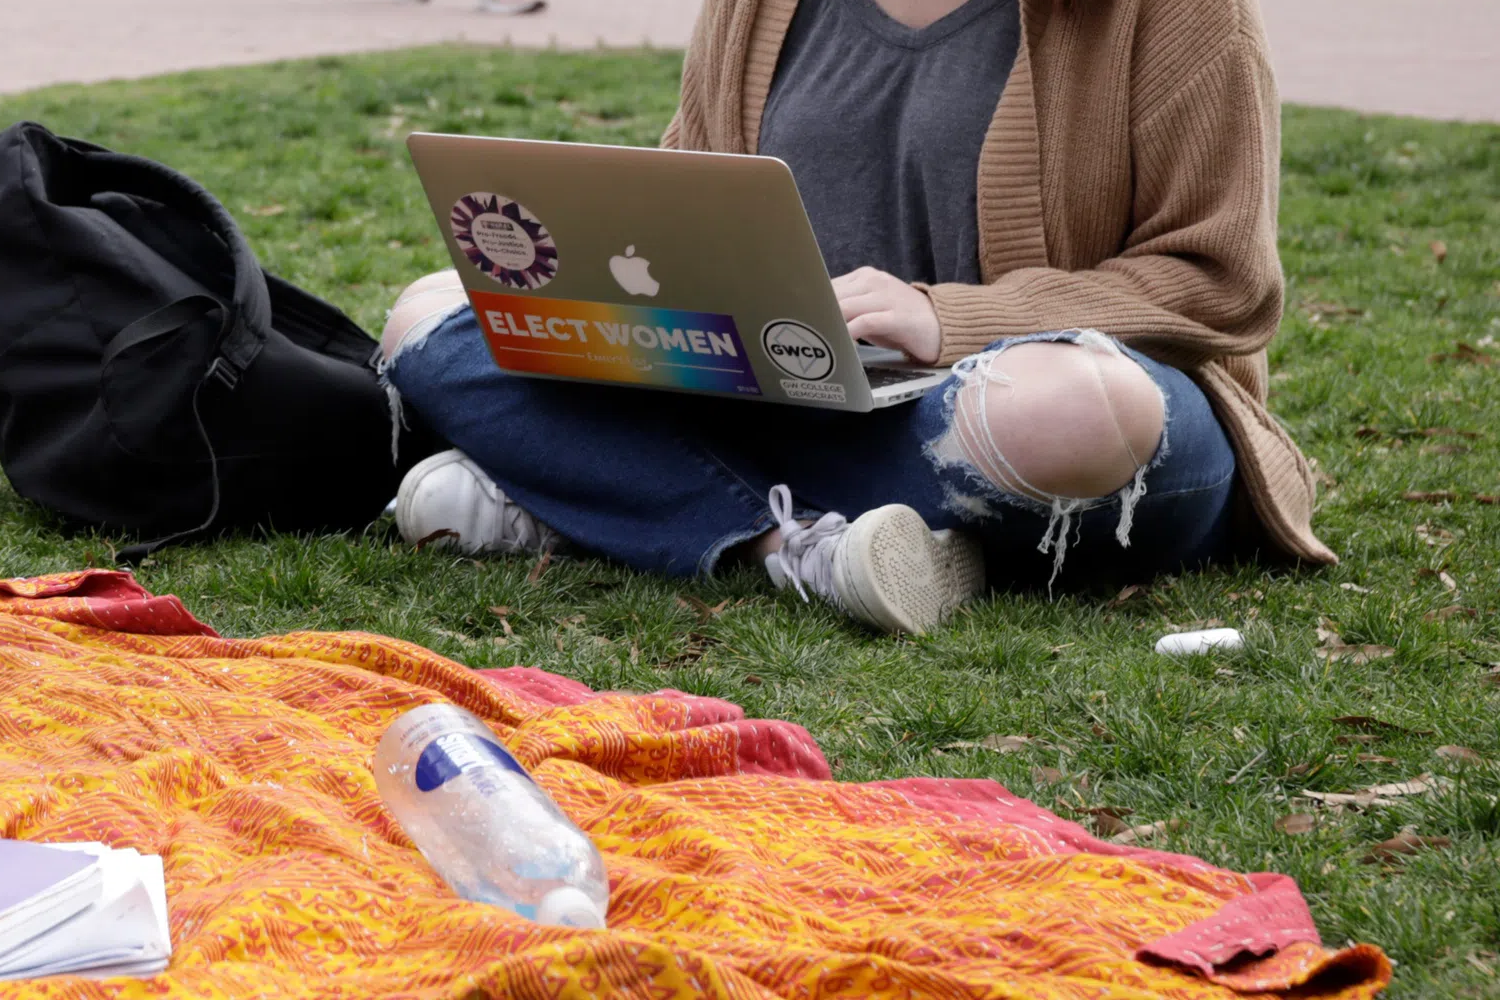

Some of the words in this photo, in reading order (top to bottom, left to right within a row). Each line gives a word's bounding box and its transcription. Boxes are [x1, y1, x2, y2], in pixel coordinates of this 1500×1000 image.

[485, 310, 588, 343] ELECT
[593, 320, 738, 358] WOMEN
[770, 344, 826, 359] GWCD
[783, 381, 798, 389] GW
[801, 382, 843, 393] COLLEGE
[789, 391, 845, 401] DEMOCRATS
